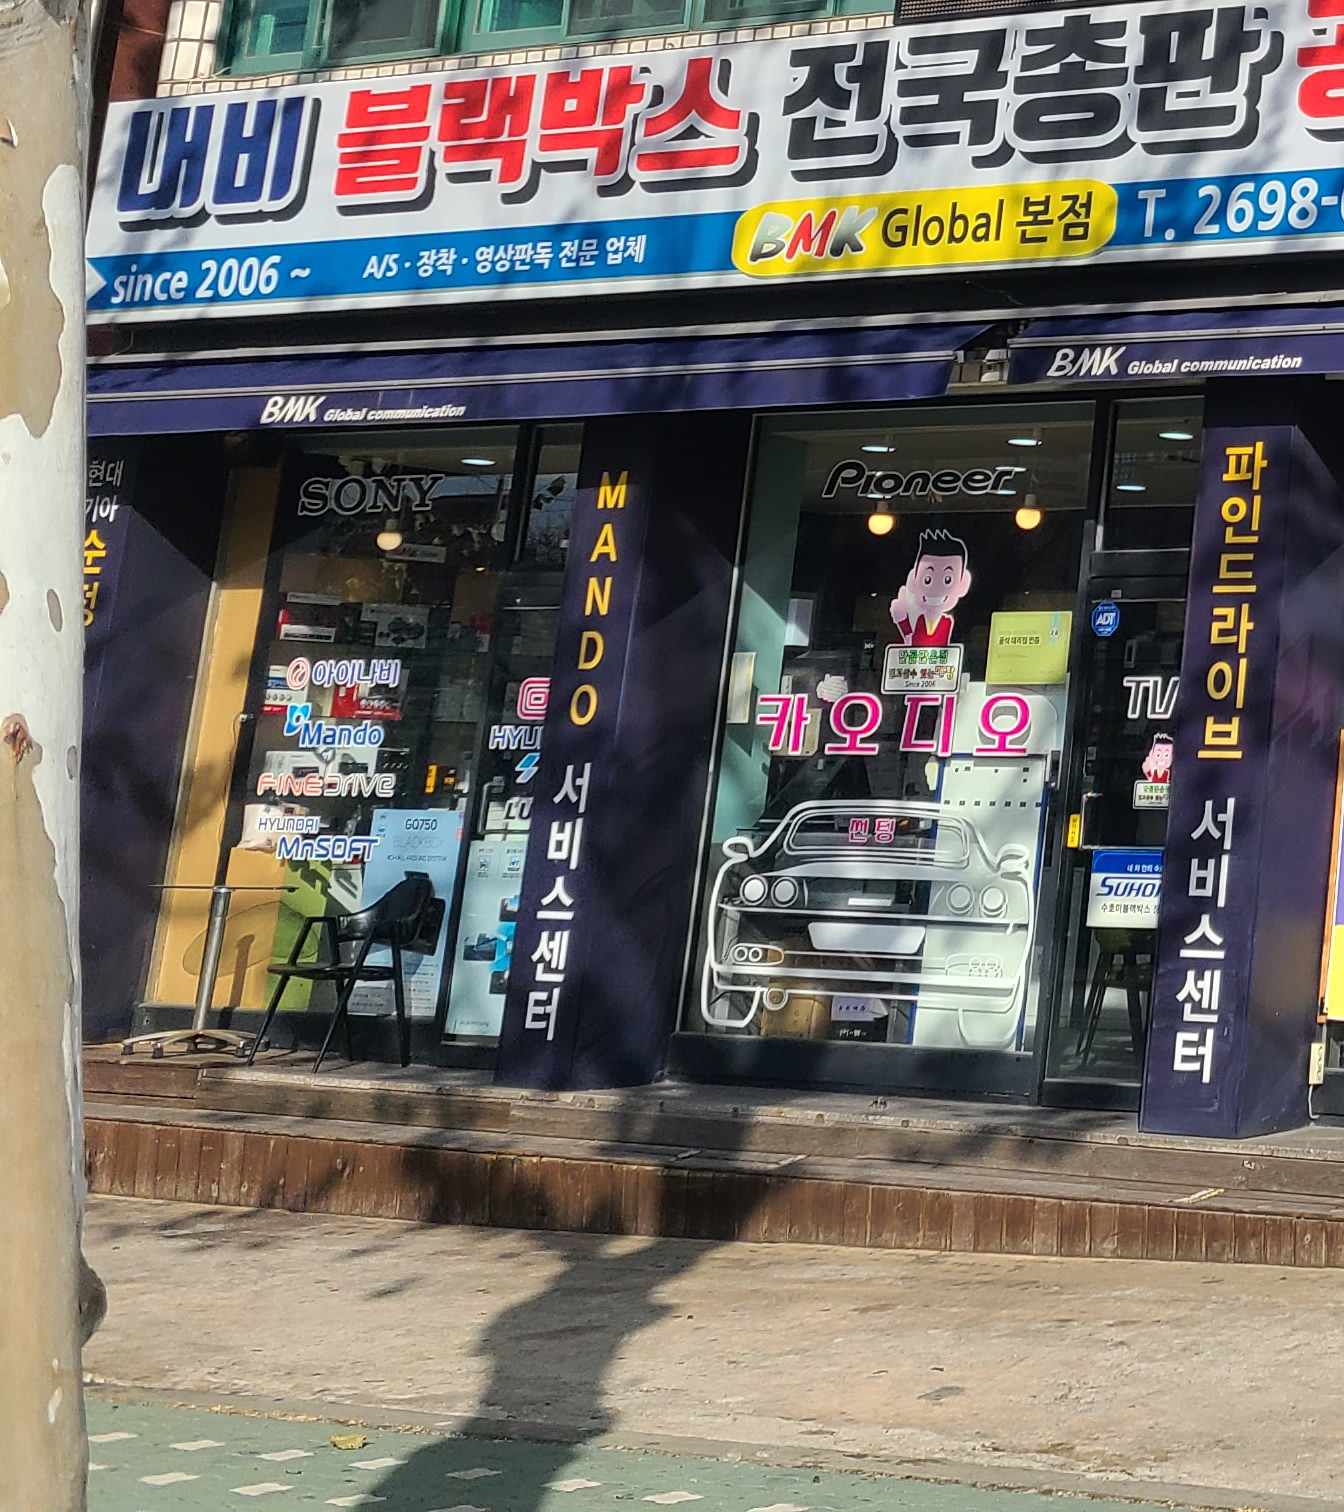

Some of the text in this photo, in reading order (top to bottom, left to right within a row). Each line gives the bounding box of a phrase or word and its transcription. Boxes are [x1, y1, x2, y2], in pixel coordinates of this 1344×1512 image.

[117, 96, 322, 229] 내비
[333, 58, 758, 214] 블랙박스
[783, 3, 1280, 178] 전국총판
[749, 191, 1095, 261] BMK Global 본점
[1140, 189, 1175, 240] T.
[361, 234, 646, 279] A/S 장착 영상판독 전문 업체
[110, 255, 279, 305] since 2006
[1046, 346, 1303, 378] BMK Global communication
[259, 394, 466, 423] BMK Global communication
[89, 459, 124, 487] 현대
[823, 458, 1015, 497] Pioneer
[298, 475, 444, 517] SONY
[569, 470, 630, 726] MANDO
[1096, 613, 1116, 625] ADT
[312, 659, 401, 687] 아이나비
[1123, 676, 1180, 720] TV
[300, 720, 384, 747] Mando
[755, 692, 1034, 757] 카오디오
[1172, 441, 1268, 1084] 파인드라이브 서비스센터
[257, 817, 321, 833] HYUNDAI
[405, 818, 437, 831] GQ750
[848, 817, 896, 844] 썬팅
[276, 836, 380, 861] MnSOFT
[524, 762, 592, 1041] 서비스센터
